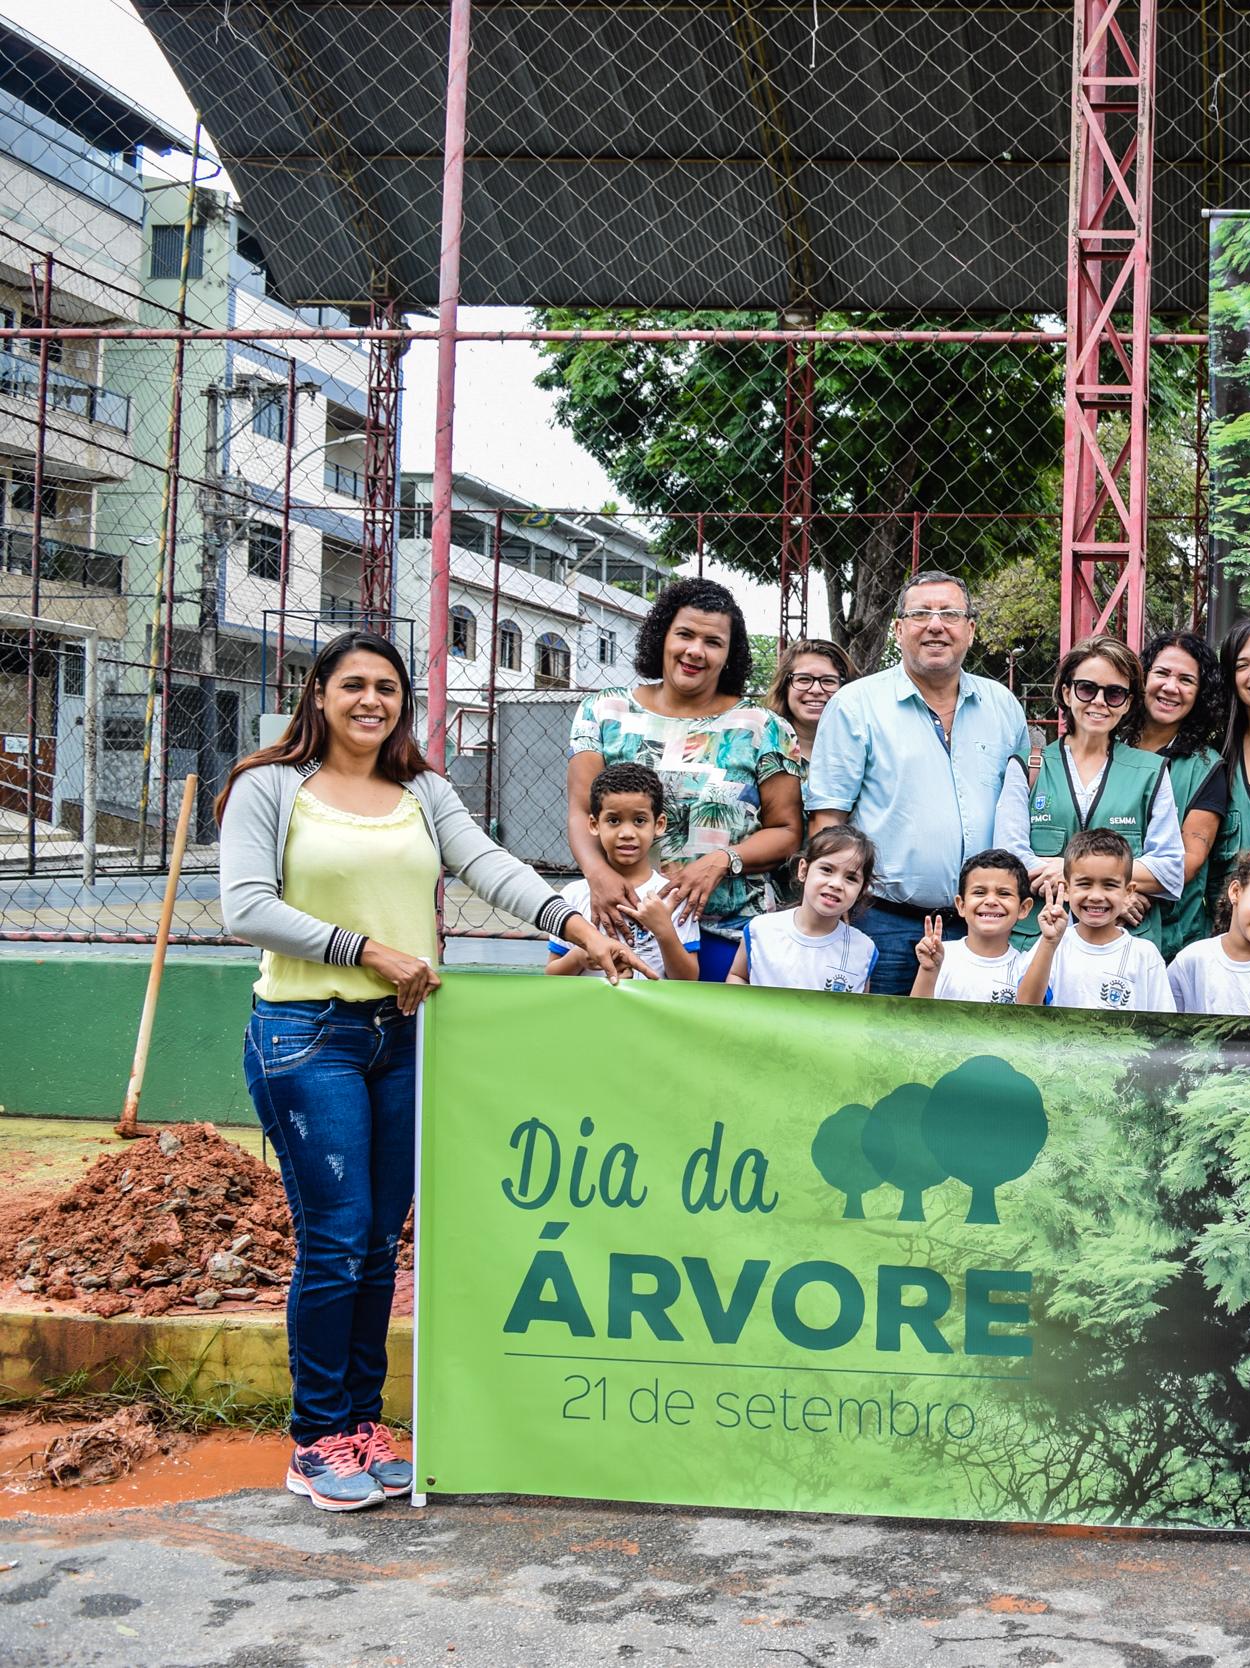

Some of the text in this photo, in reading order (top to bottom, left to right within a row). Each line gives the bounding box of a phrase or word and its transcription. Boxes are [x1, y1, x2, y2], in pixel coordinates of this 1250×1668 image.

[1031, 814, 1051, 823] PMCI
[1109, 817, 1137, 825] SEMMA
[501, 1115, 779, 1214] Dia da
[502, 1221, 1034, 1357] ÁRVORE
[561, 1374, 976, 1441] 21 de setembro
